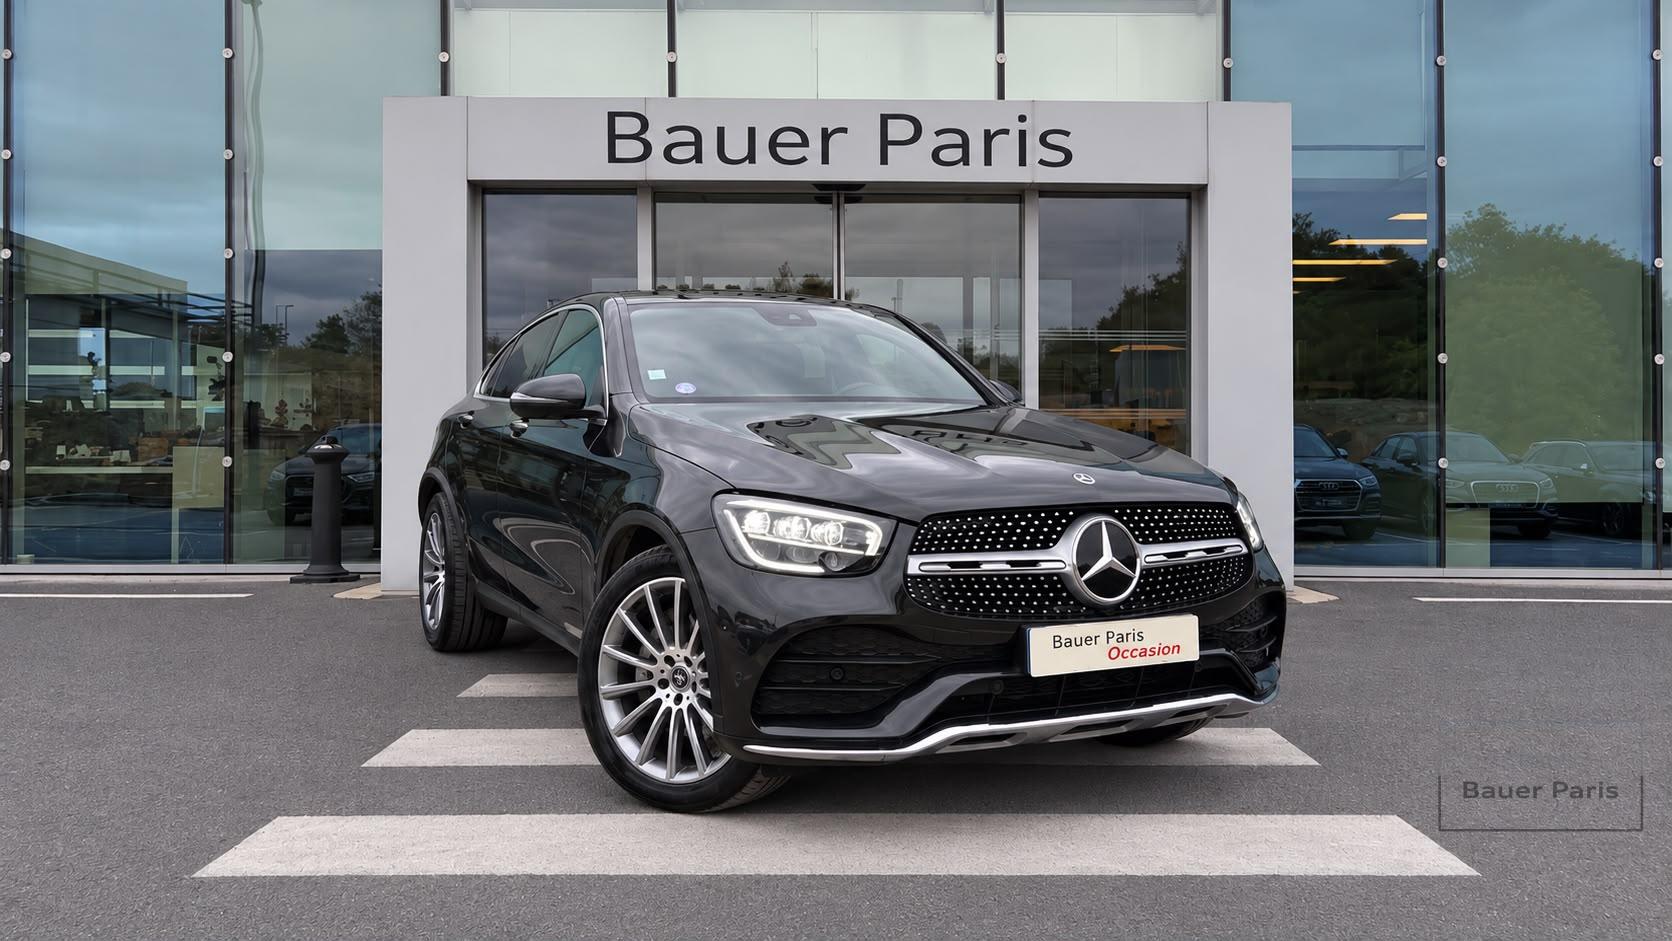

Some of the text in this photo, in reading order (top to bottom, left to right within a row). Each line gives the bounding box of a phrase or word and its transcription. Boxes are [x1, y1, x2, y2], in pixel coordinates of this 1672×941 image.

[606, 111, 1074, 168] Bauer Paris
[1052, 628, 1145, 649] Bauer Paris
[1107, 642, 1181, 661] Occasion
